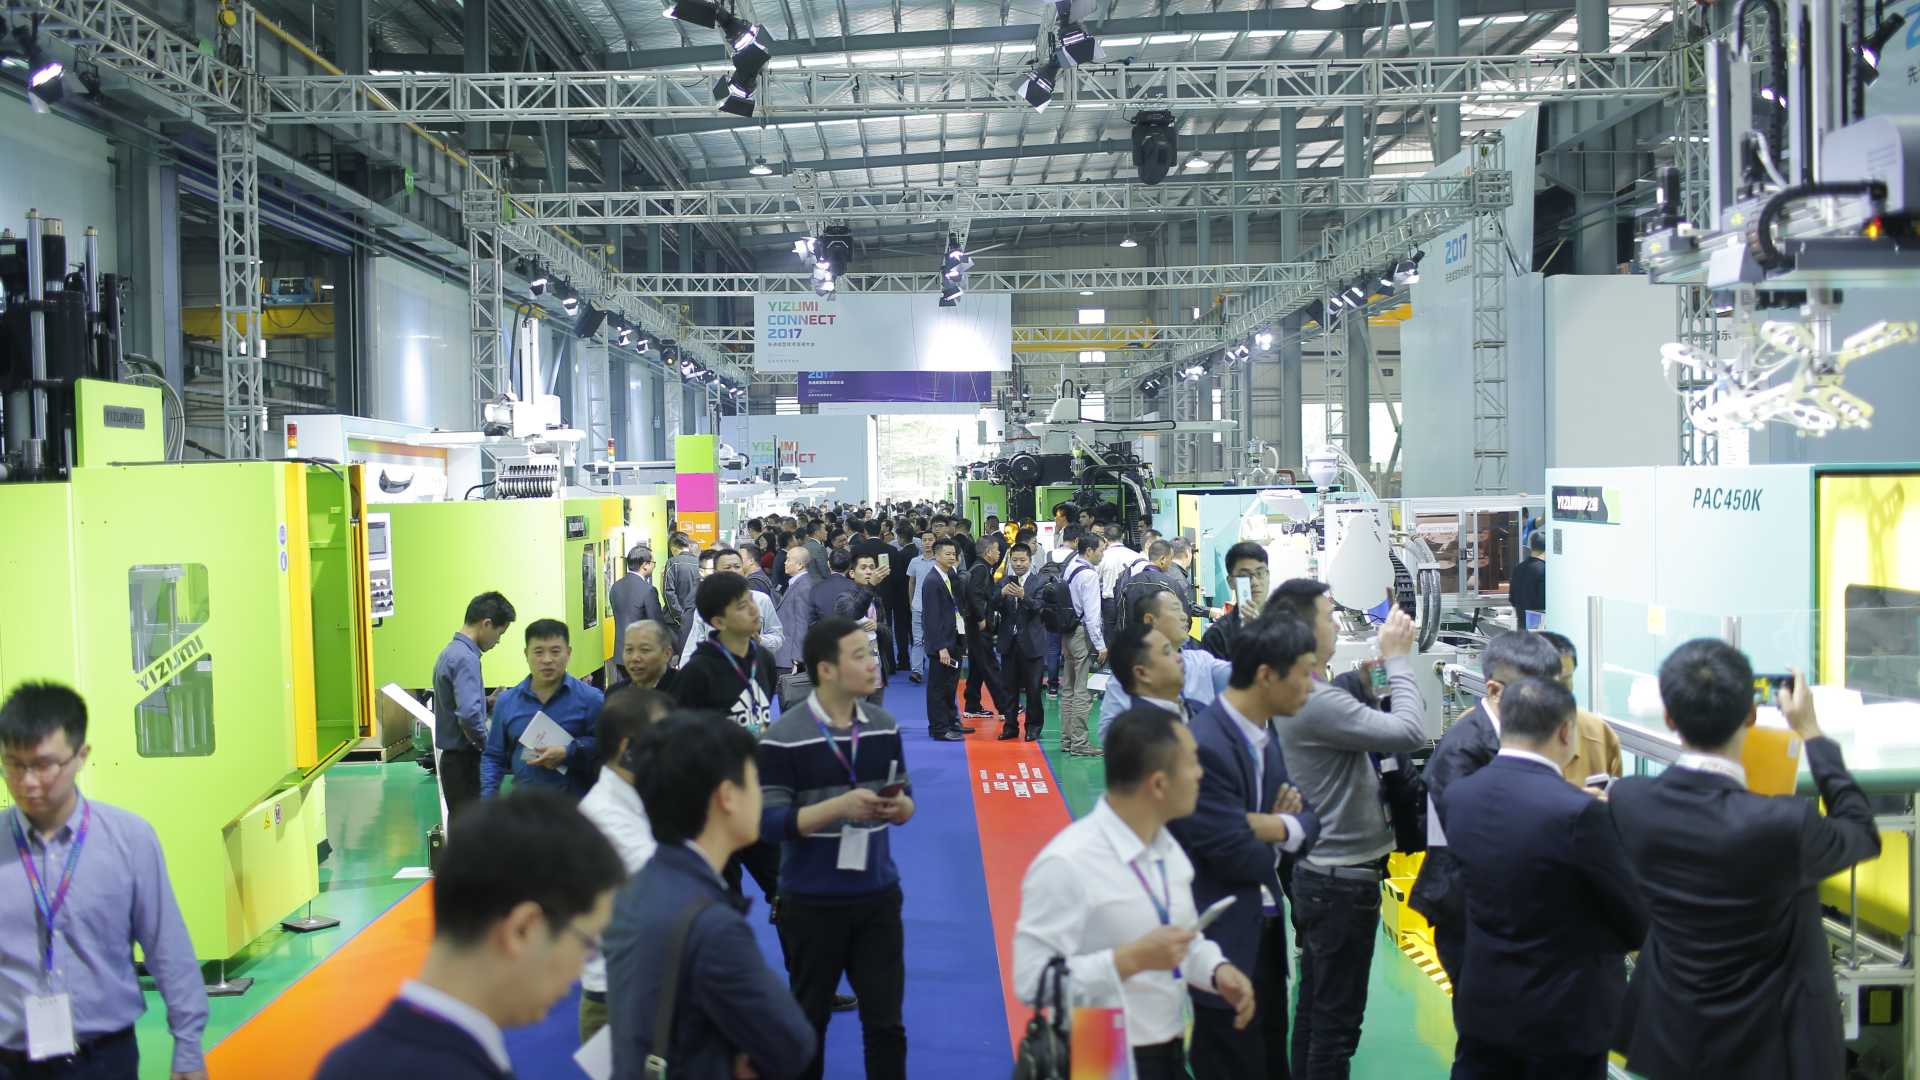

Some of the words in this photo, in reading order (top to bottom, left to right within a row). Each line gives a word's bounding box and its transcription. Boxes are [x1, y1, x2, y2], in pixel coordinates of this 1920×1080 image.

[1445, 233, 1468, 264] 2017
[768, 301, 818, 312] YIZUMI
[768, 314, 836, 325] CONNECT
[768, 328, 802, 339] 2017
[1692, 487, 1764, 512] PAC450K
[136, 634, 204, 692] YIZUMI
